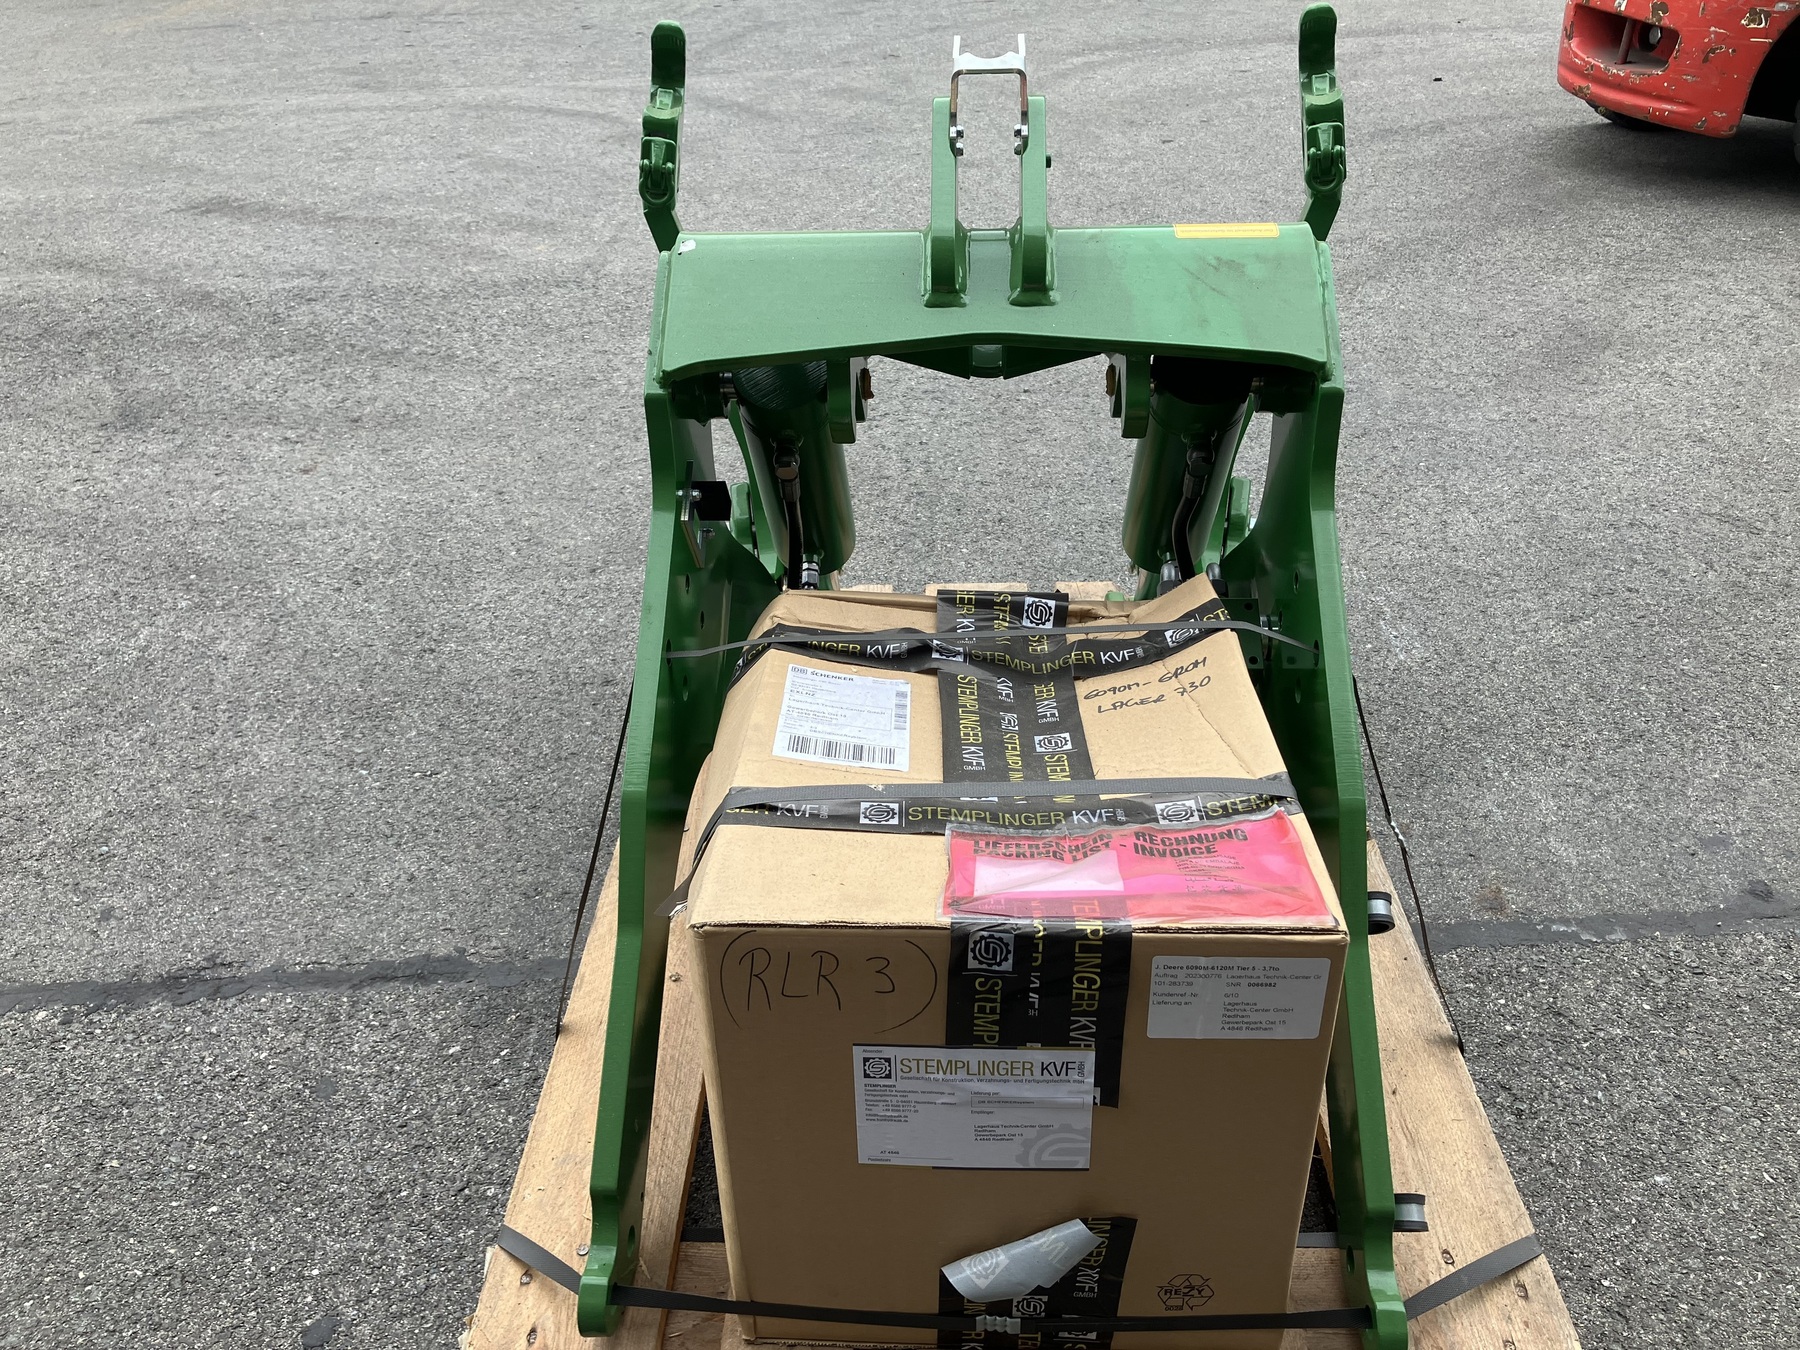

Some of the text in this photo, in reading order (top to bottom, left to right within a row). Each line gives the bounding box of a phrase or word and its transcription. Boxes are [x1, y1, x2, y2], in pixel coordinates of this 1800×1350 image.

[866, 643, 900, 659] KVF
[971, 650, 1096, 675] STEMPLINGER
[1100, 649, 1135, 665] KVF
[811, 671, 854, 681] SCHENKER
[1098, 676, 1211, 713] LAGER 730
[957, 674, 982, 744] STEMPLINGER
[1036, 700, 1059, 717] KVF
[961, 746, 985, 766] KVF
[776, 803, 819, 819] KVF
[908, 806, 1066, 825] STEMPLINGER
[1072, 808, 1115, 824] KVF
[974, 832, 1113, 852] LIEFERSCHEIN
[1134, 828, 1248, 847] RECHNUNG
[974, 848, 1064, 861] PACKING
[1071, 841, 1112, 862] LIST
[1134, 842, 1218, 858] INVOICE
[900, 1057, 1086, 1078] STEMPLINGER KVF GMBH
[1163, 1285, 1205, 1297] REZY
